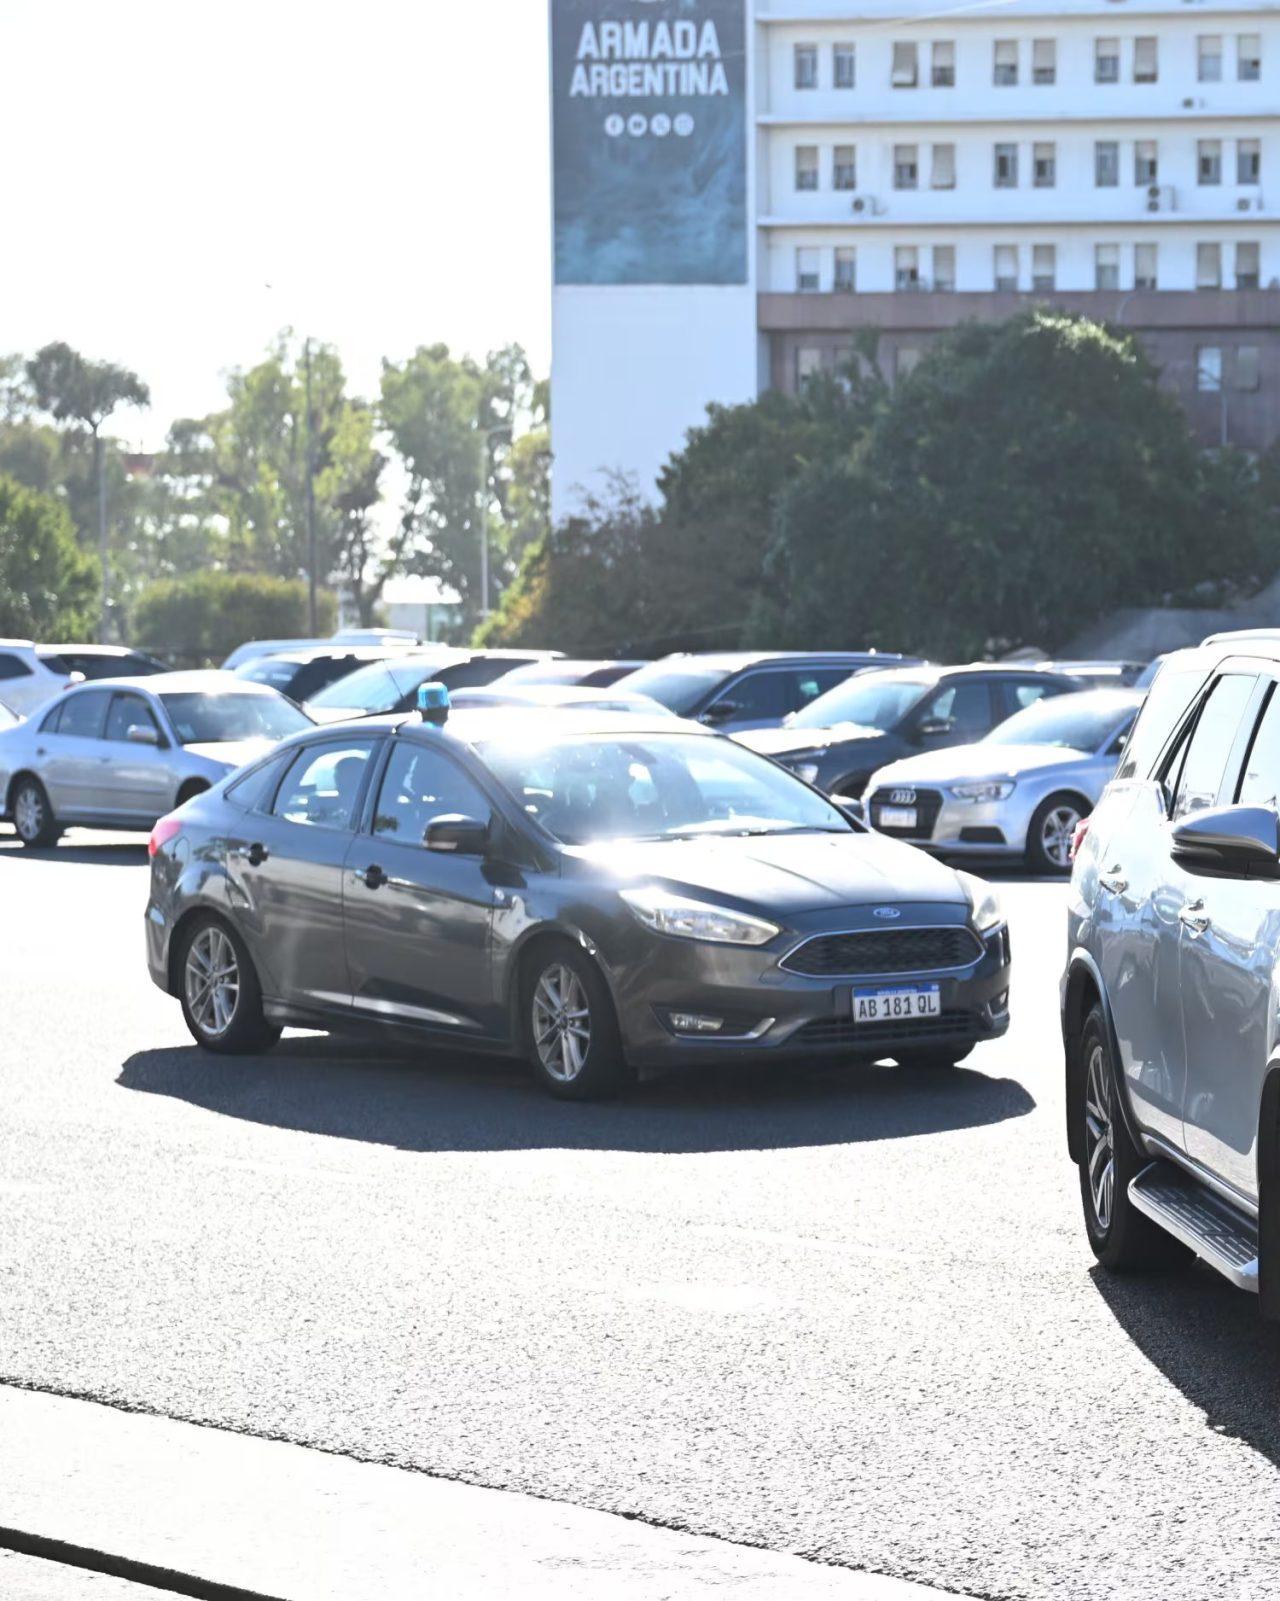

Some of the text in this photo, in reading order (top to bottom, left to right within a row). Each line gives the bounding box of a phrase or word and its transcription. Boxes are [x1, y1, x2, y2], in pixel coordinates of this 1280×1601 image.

[576, 19, 723, 60] ARMADA
[569, 61, 730, 97] ARGENTINA
[859, 994, 937, 1018] AB 181 QL
